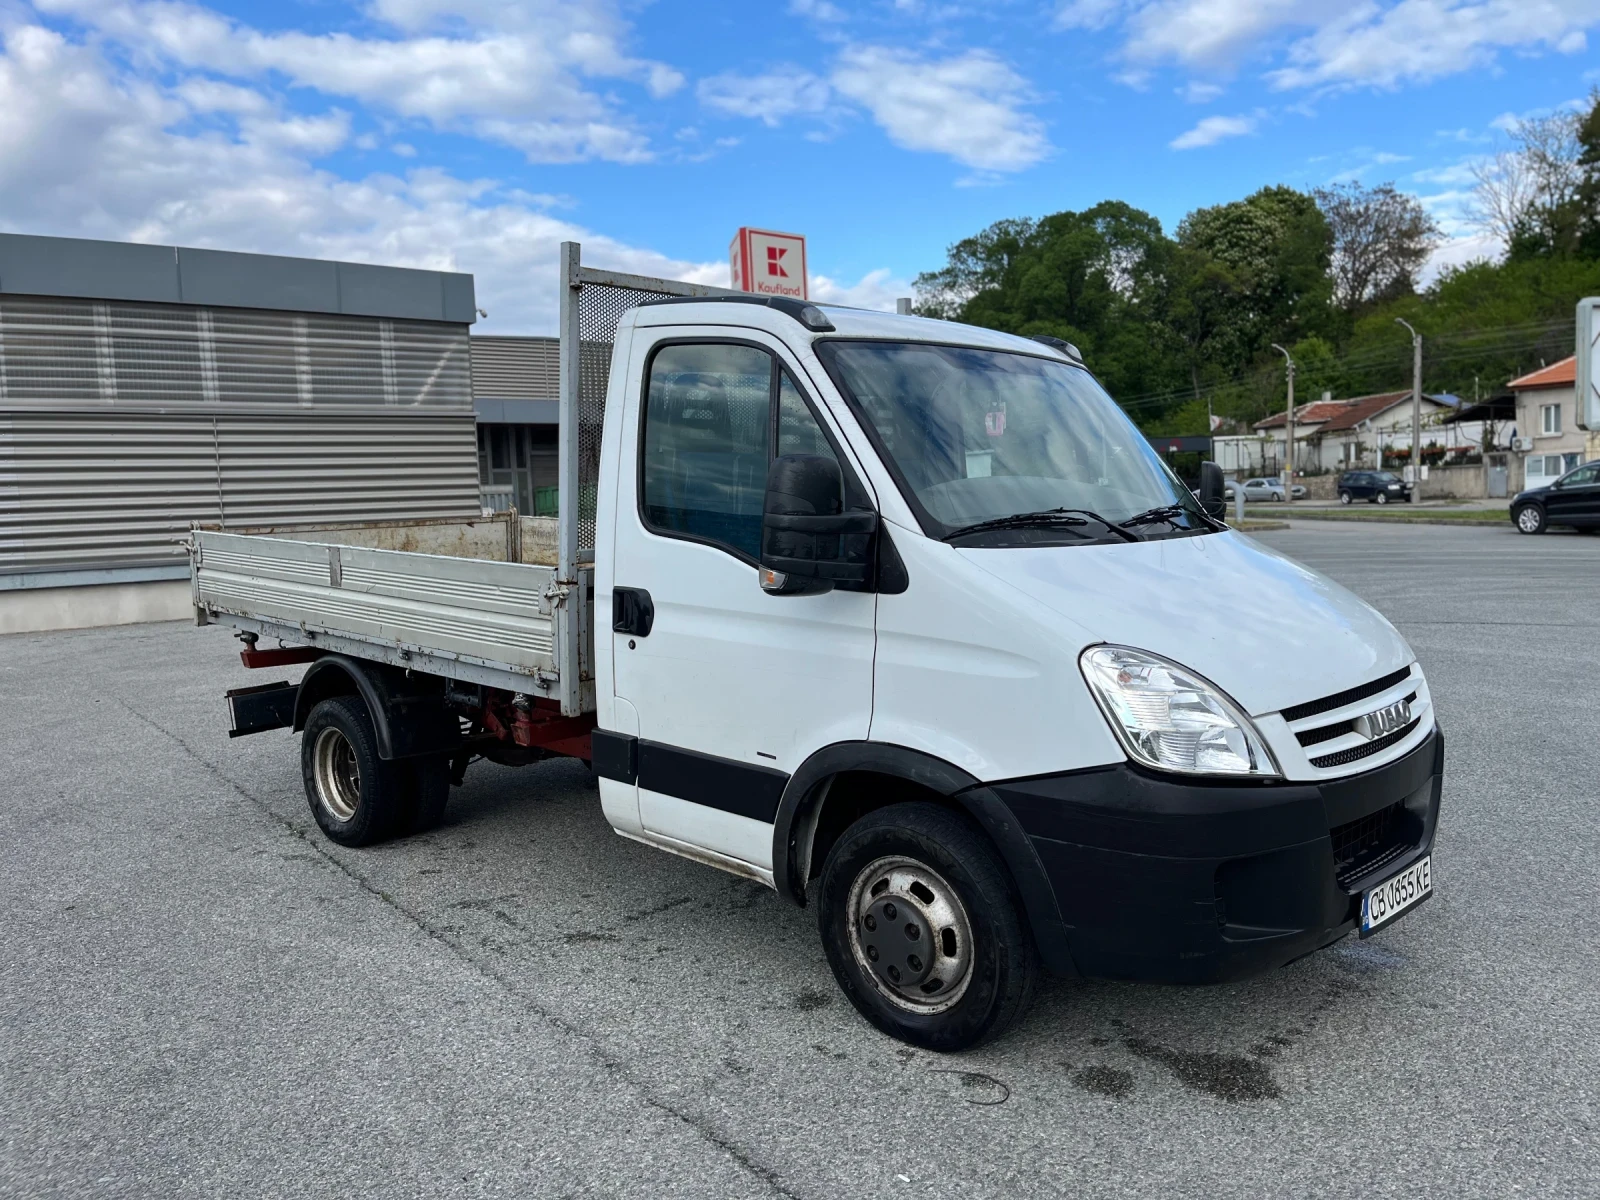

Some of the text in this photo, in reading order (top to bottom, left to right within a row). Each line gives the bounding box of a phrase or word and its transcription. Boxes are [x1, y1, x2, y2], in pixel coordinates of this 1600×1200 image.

[767, 246, 789, 278] K
[758, 281, 800, 296] Kaufland
[1370, 860, 1429, 920] CB 0855 KE
